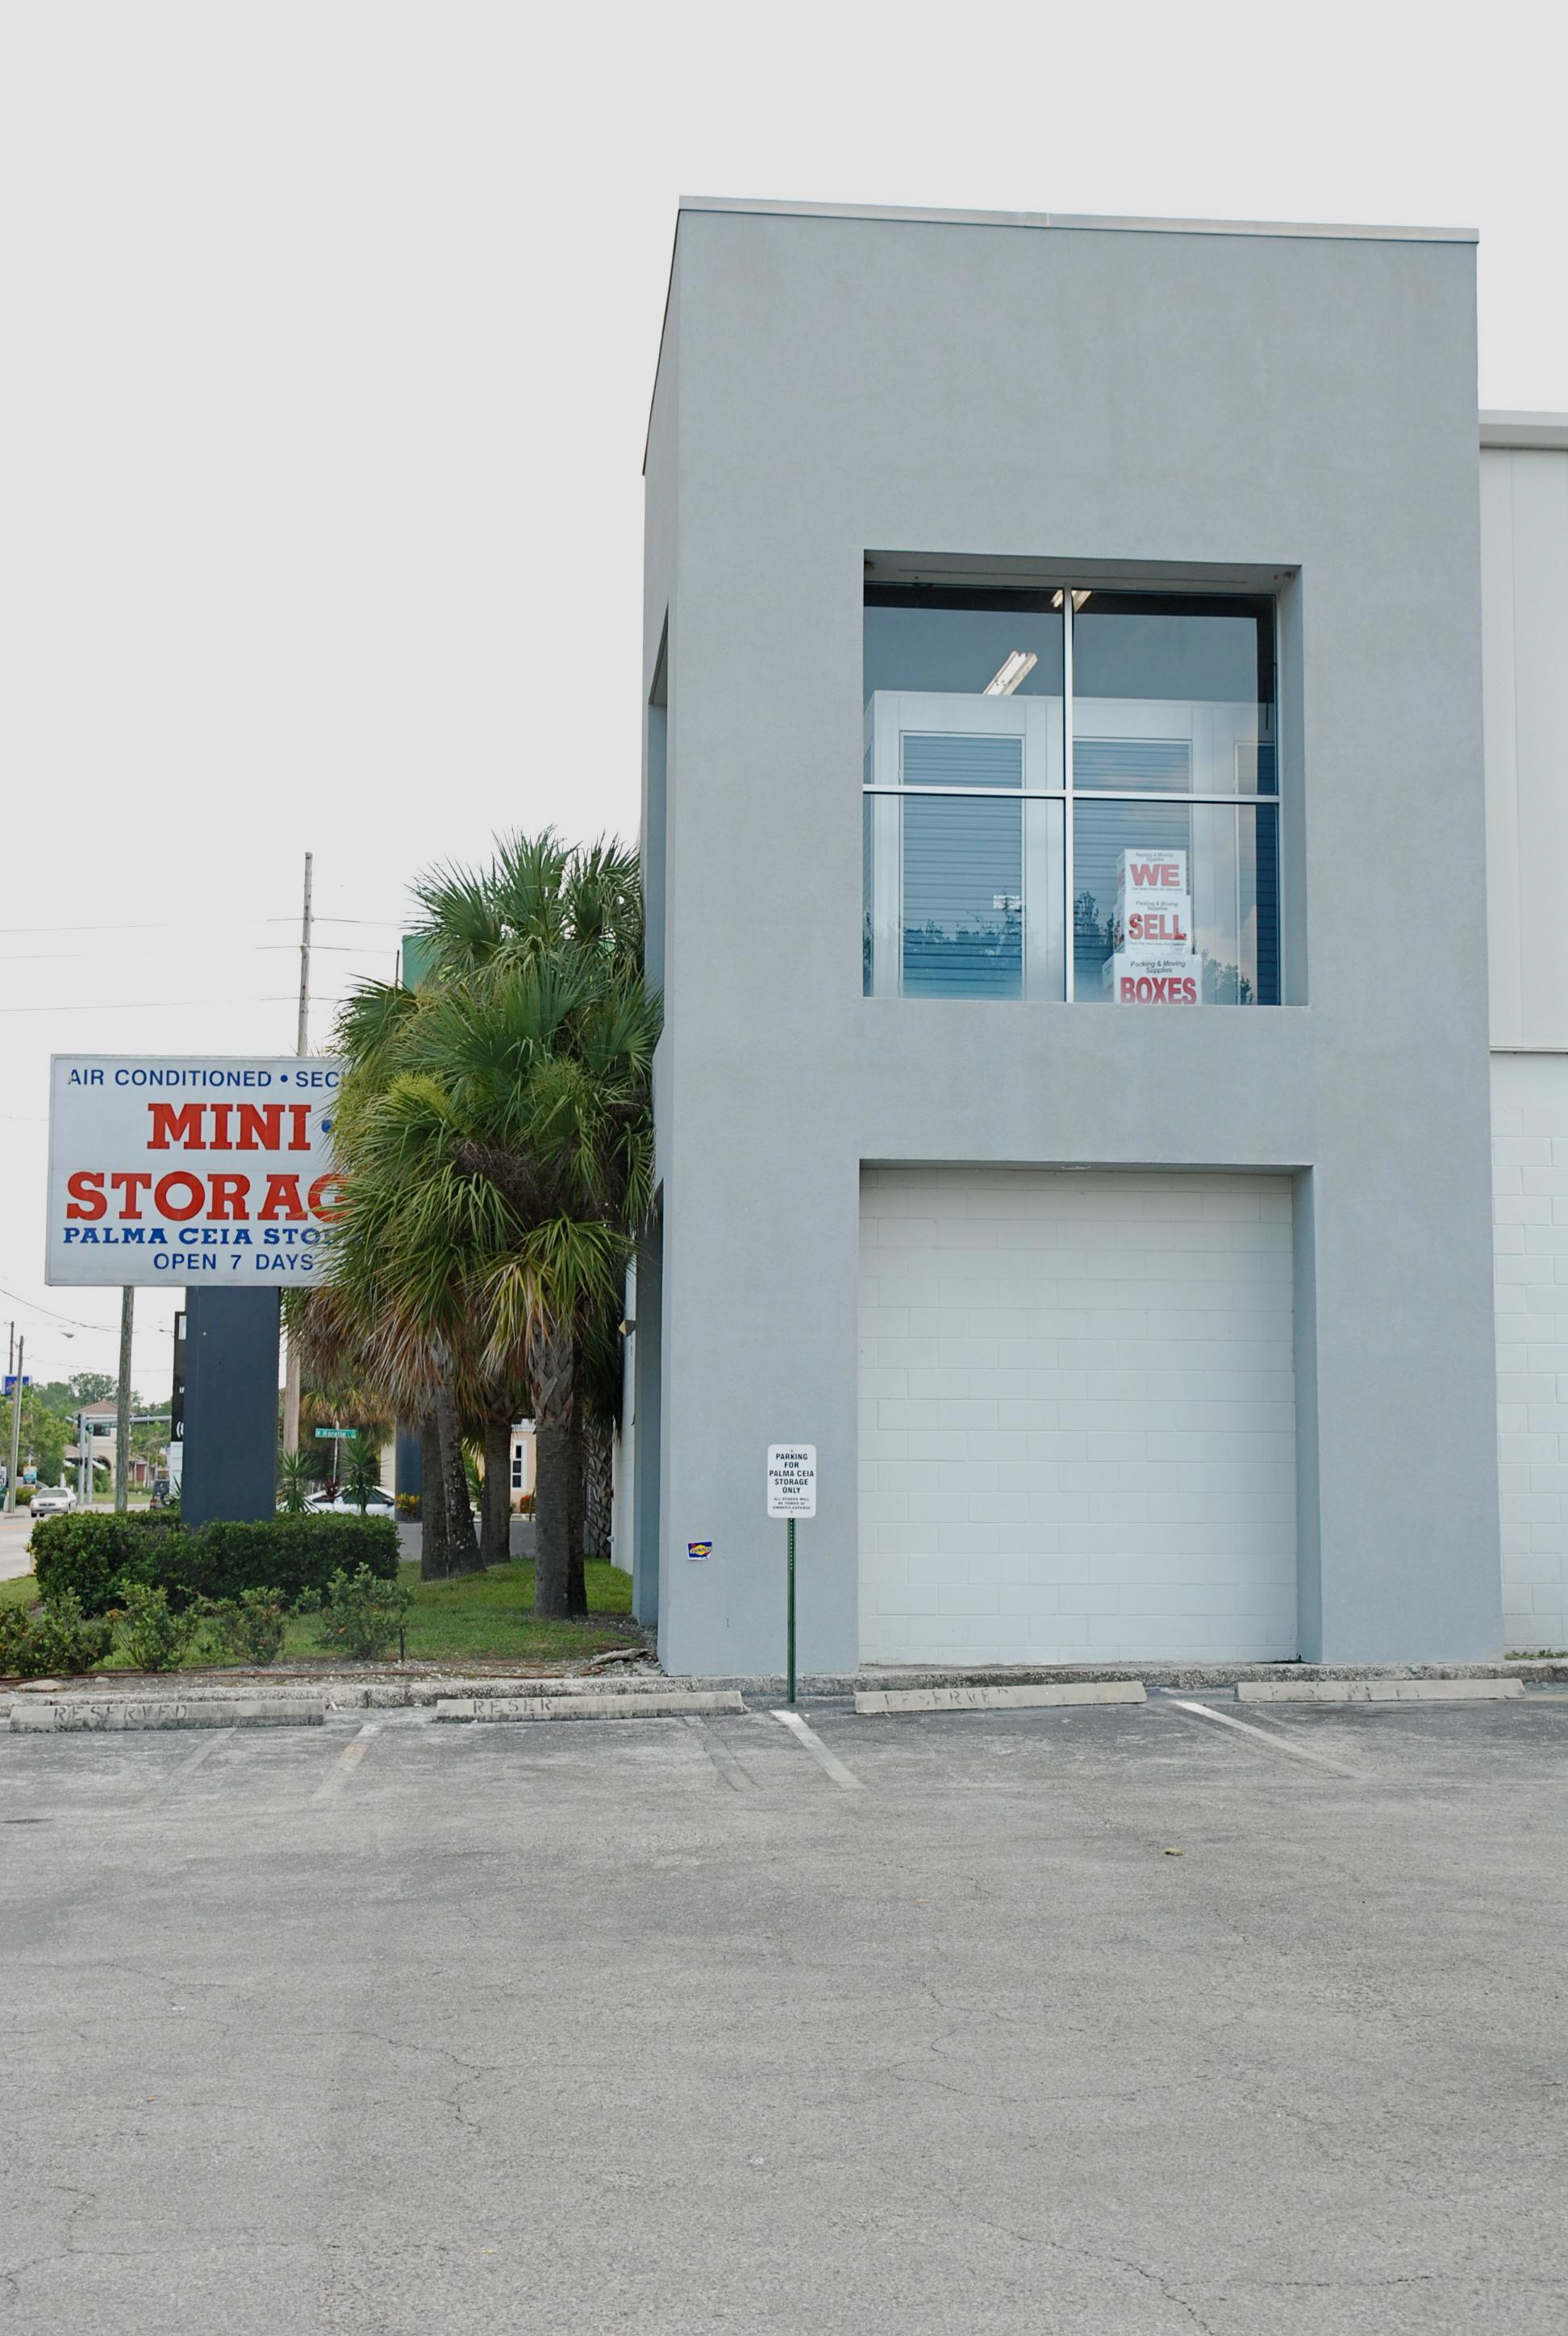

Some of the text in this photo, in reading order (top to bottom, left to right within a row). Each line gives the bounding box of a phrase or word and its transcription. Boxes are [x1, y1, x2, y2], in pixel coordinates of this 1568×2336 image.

[1130, 864, 1180, 886] WE
[1128, 913, 1187, 940] SELL
[1120, 977, 1197, 1005] BOXES
[68, 1070, 104, 1085] AIR
[115, 1070, 272, 1087] CONDITIONED
[147, 1103, 311, 1150] MINI
[64, 1228, 168, 1244] PALMA
[179, 1228, 252, 1245] CEIA
[154, 1254, 314, 1270] OPEN 7 DAYS
